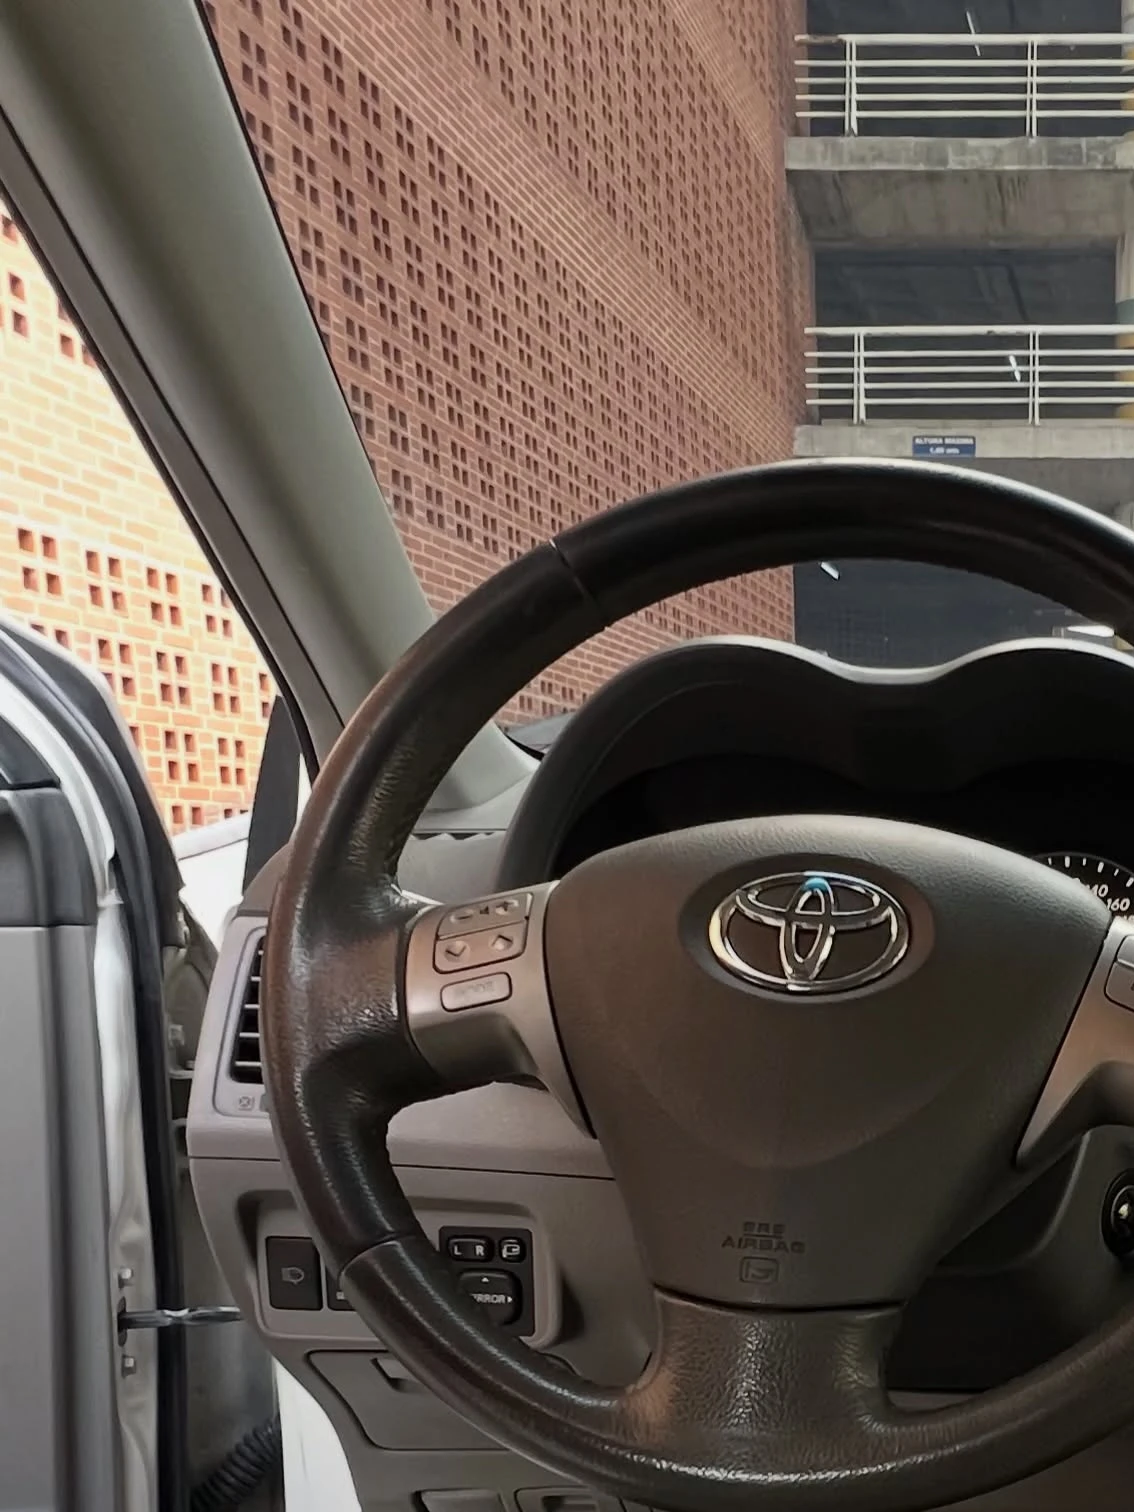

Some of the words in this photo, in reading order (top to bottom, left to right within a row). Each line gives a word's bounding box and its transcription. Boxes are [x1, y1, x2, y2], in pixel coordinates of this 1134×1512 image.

[1106, 898, 1130, 911] 160
[453, 1245, 462, 1256] L
[475, 1245, 485, 1256] R
[721, 1235, 806, 1253] AIRBAG
